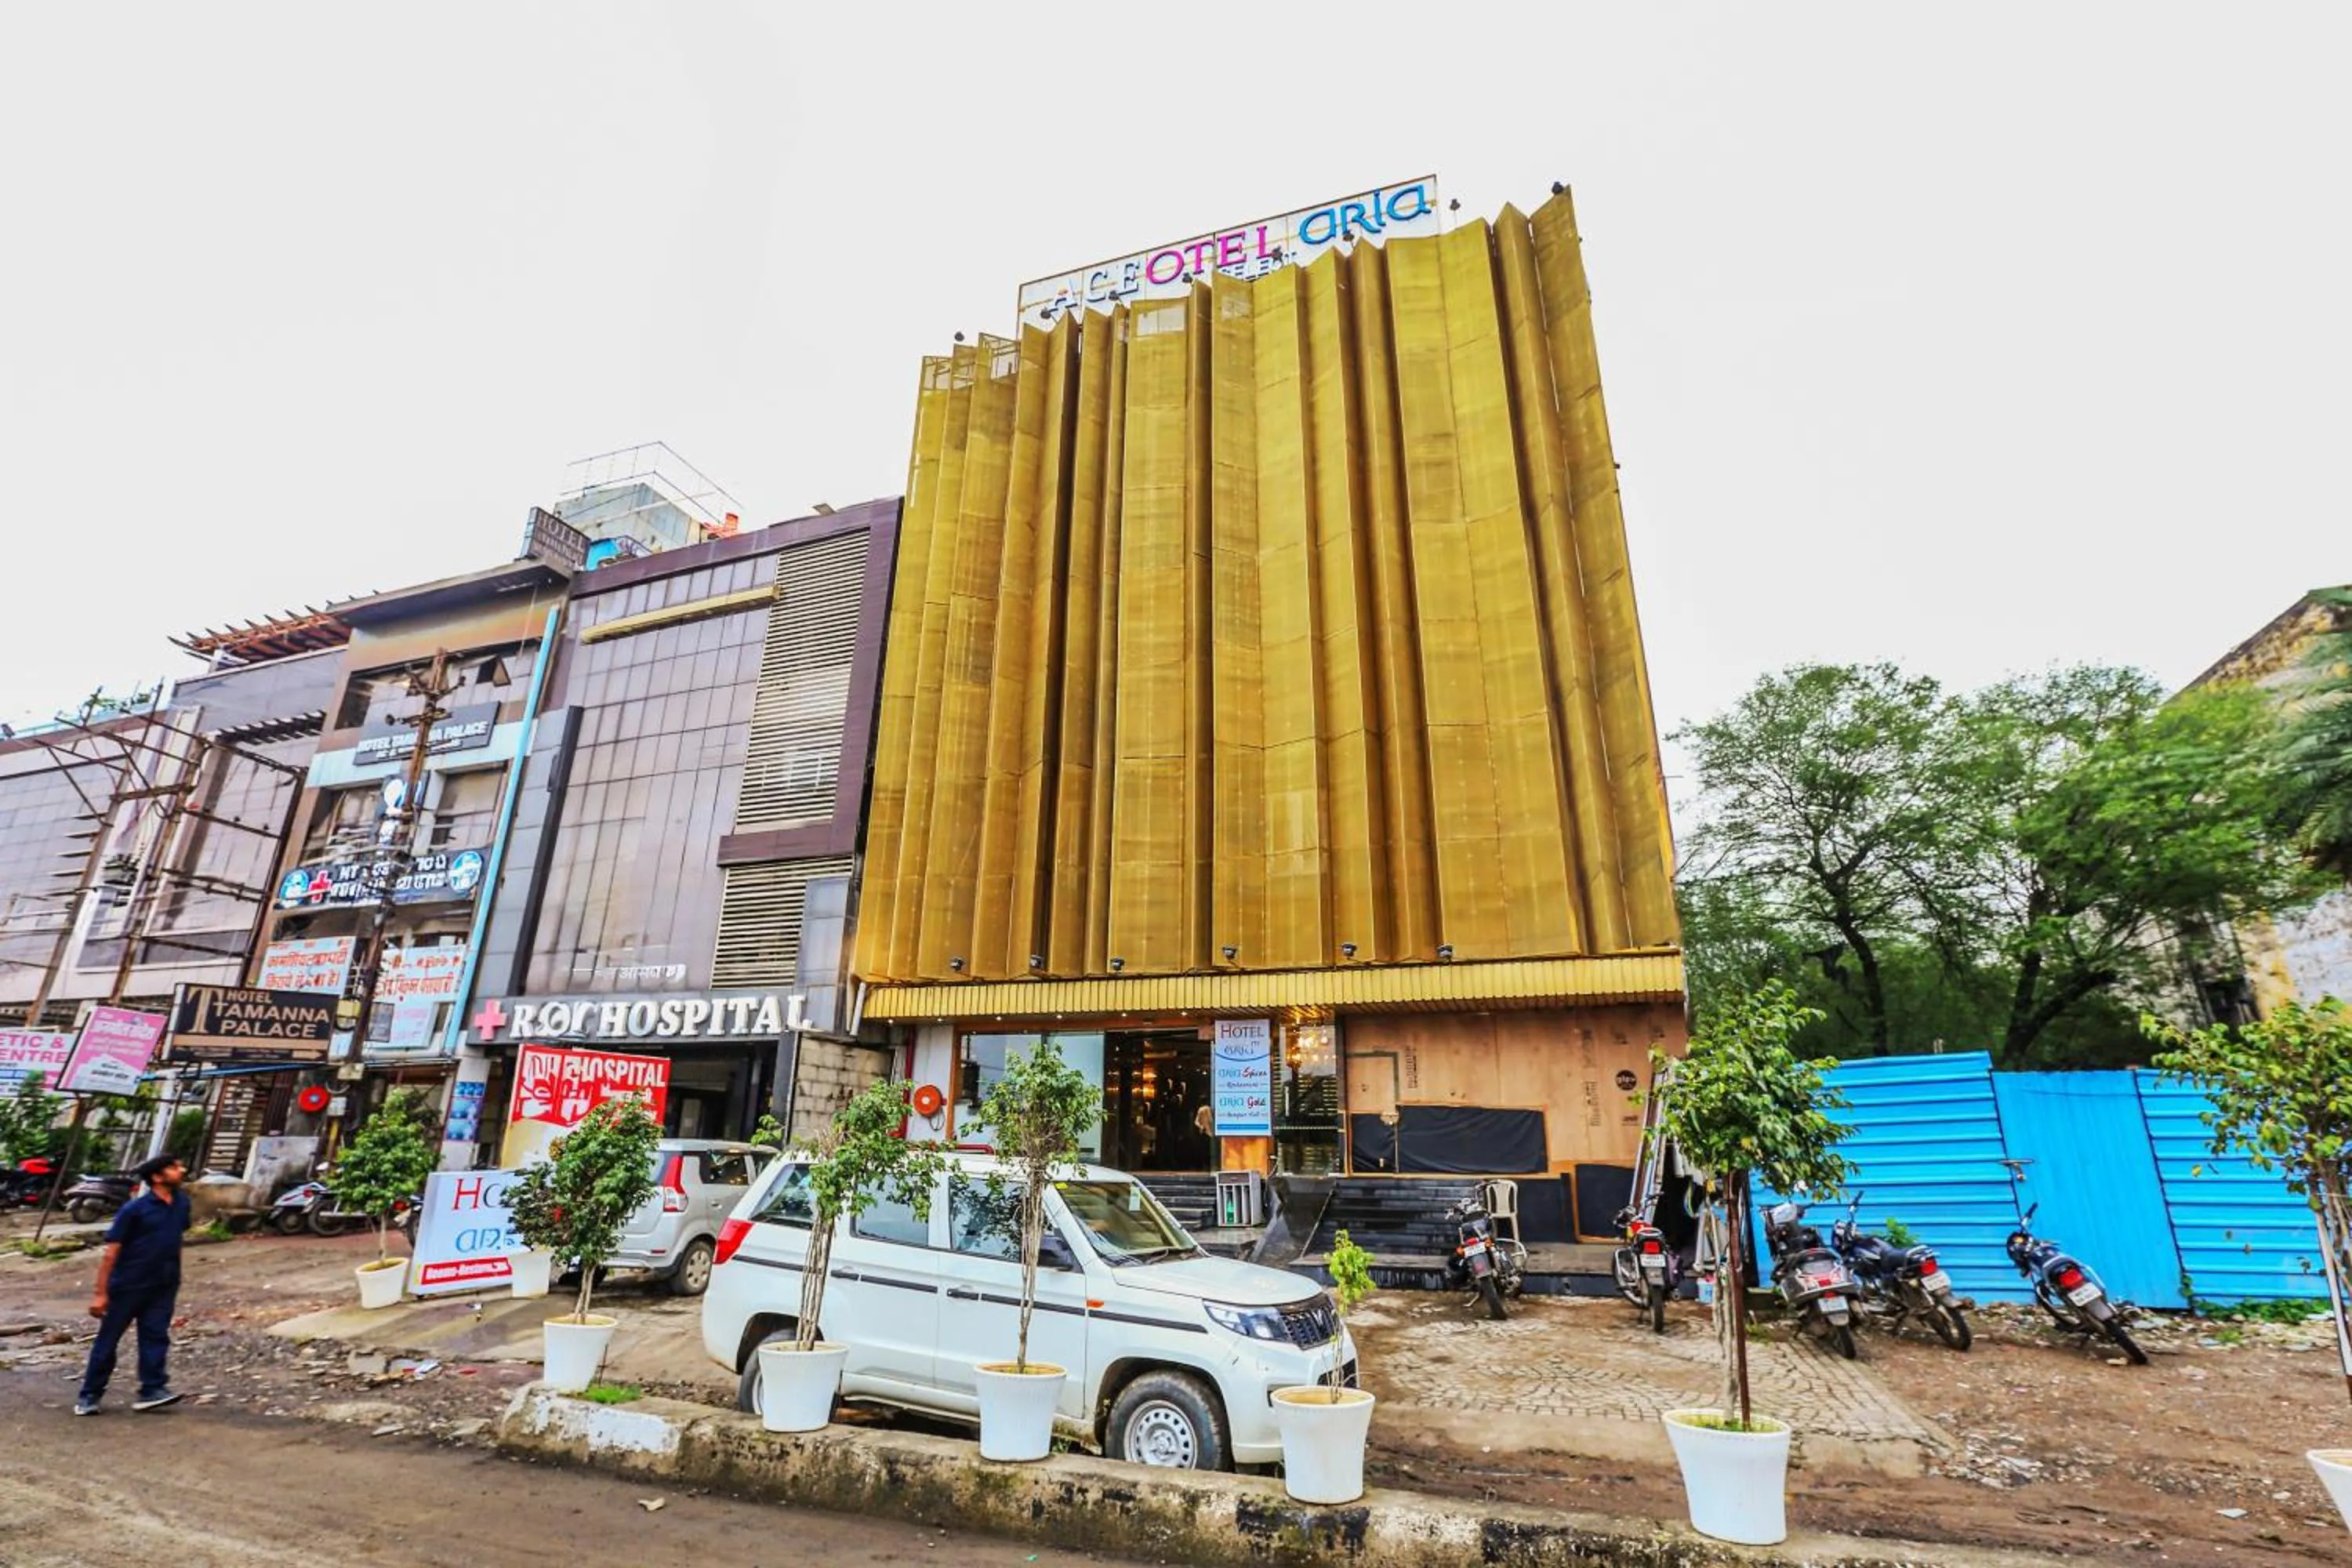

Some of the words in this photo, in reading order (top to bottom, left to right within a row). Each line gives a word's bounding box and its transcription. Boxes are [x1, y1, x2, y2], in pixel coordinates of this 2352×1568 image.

[227, 990, 273, 1003] HOTEL
[213, 1002, 330, 1023] TAMANNA
[596, 995, 815, 1039] HOSPITAL
[220, 1020, 318, 1038] PALACE
[1221, 1024, 1264, 1038] HOTEL
